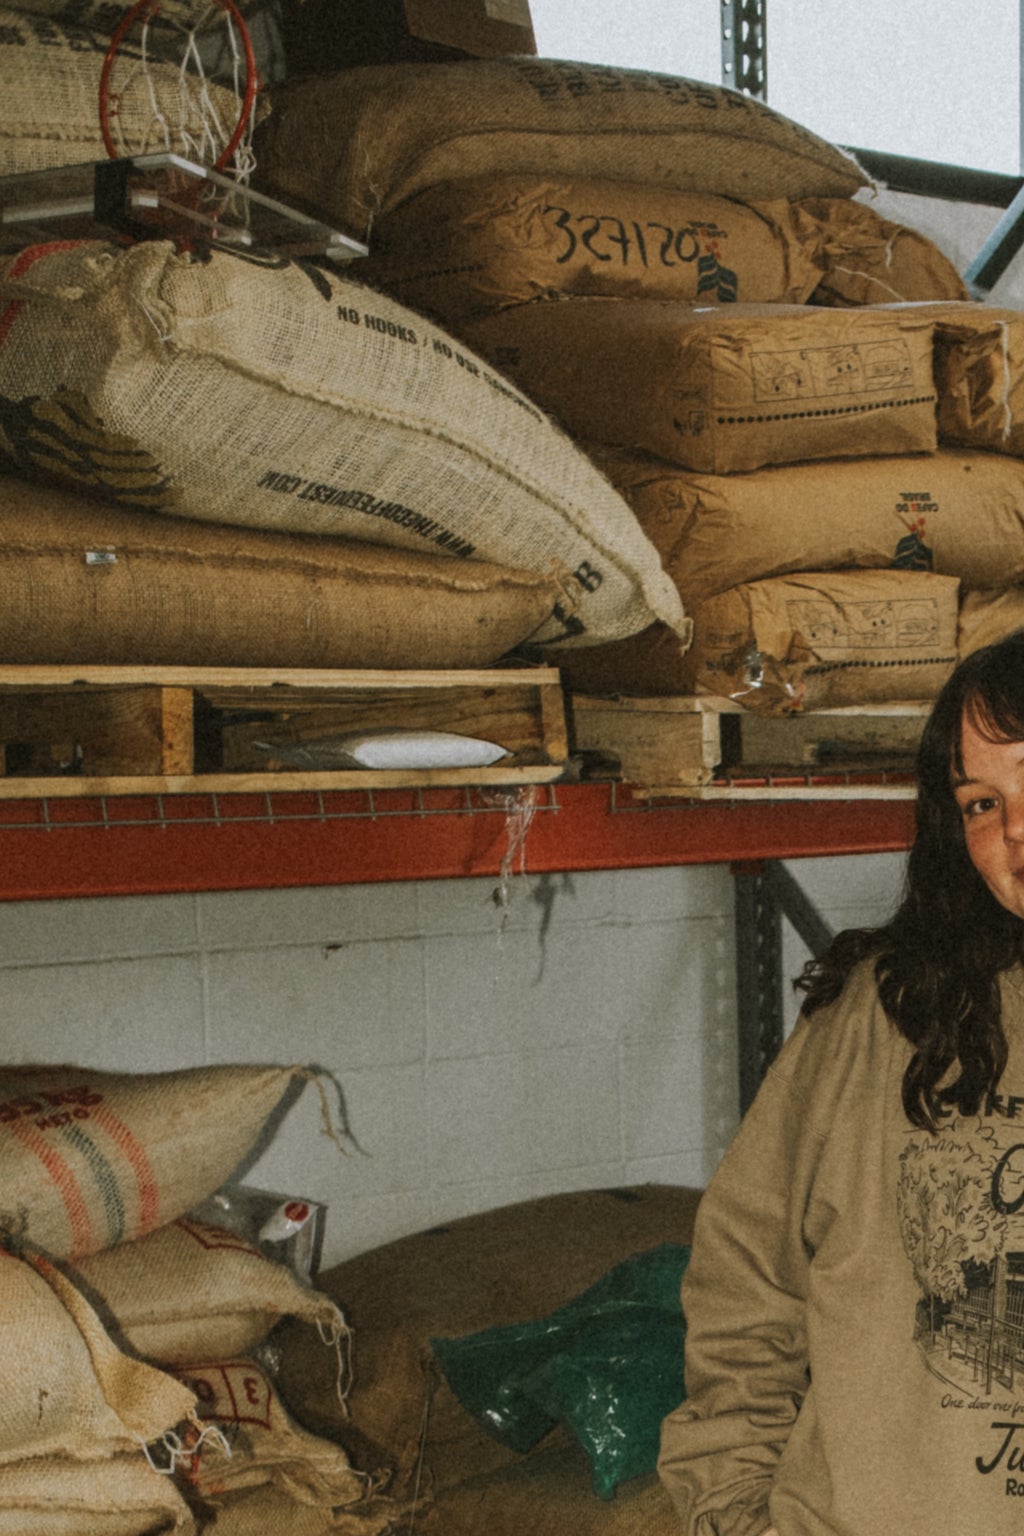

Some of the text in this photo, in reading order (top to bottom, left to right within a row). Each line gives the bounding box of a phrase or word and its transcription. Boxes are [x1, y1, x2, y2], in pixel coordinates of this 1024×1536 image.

[337, 305, 360, 325] NO
[364, 314, 417, 345] HOOKS
[941, 1393, 965, 1410] One
[967, 1396, 990, 1411] door
